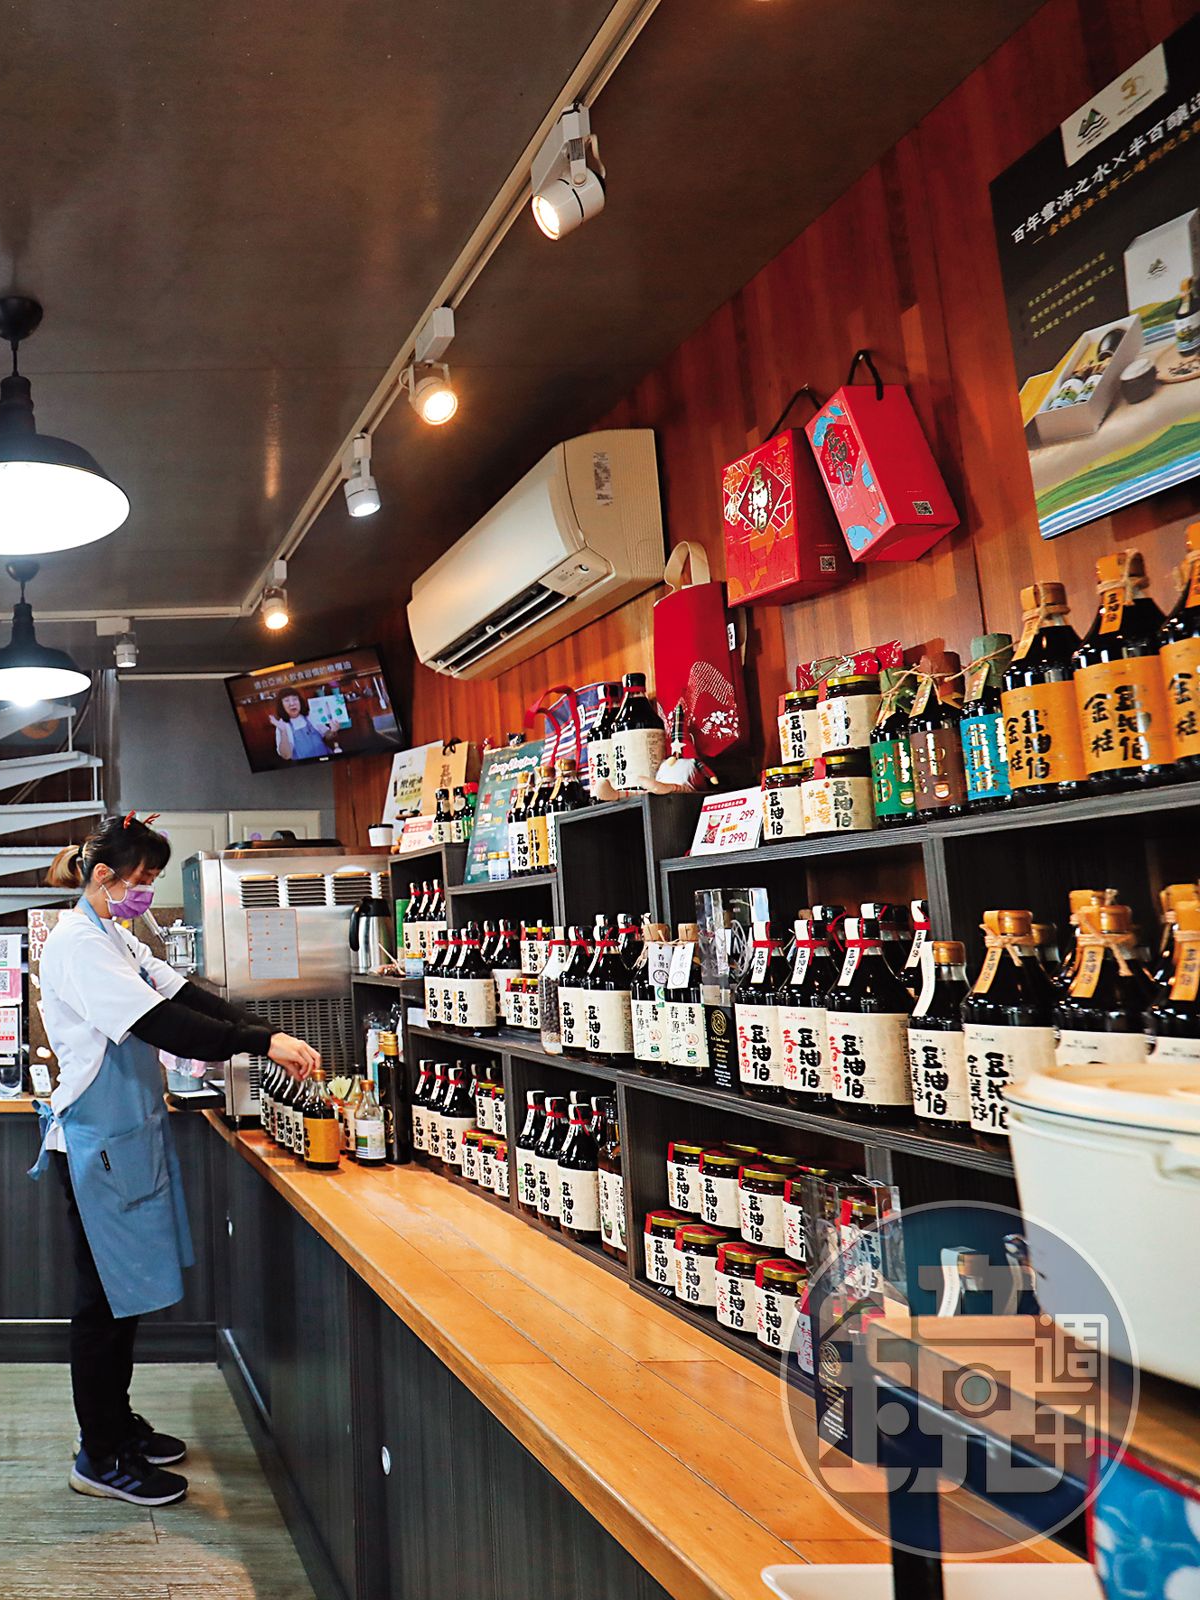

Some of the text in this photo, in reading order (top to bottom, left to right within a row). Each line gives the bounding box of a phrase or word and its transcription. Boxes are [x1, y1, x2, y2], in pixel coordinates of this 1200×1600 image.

[1022, 709, 1052, 780] 豆油伯
[1084, 692, 1115, 759] 金桂
[768, 791, 785, 836] 豆油伯
[832, 780, 854, 828] 豆油伯
[563, 1001, 575, 1044] 豆油伯
[588, 1005, 601, 1049] 豆油伯
[750, 1024, 772, 1082] 豆油伯
[798, 1027, 822, 1089] 豆油伯
[842, 1034, 867, 1100] 豆油伯
[922, 1045, 950, 1116] 豆油伯
[524, 1162, 537, 1202] 豆油伯
[539, 1170, 551, 1212] 豆油伯
[562, 1181, 574, 1225] 豆油伯
[676, 1166, 690, 1210] 豆油伯
[704, 1177, 718, 1223] 豆油伯
[748, 1193, 765, 1243] 豆油伯
[653, 1238, 669, 1283] 豆油伯
[684, 1255, 701, 1302] 豆油伯
[727, 1278, 746, 1328] 豆油伯
[764, 1293, 782, 1346] 豆油伯
